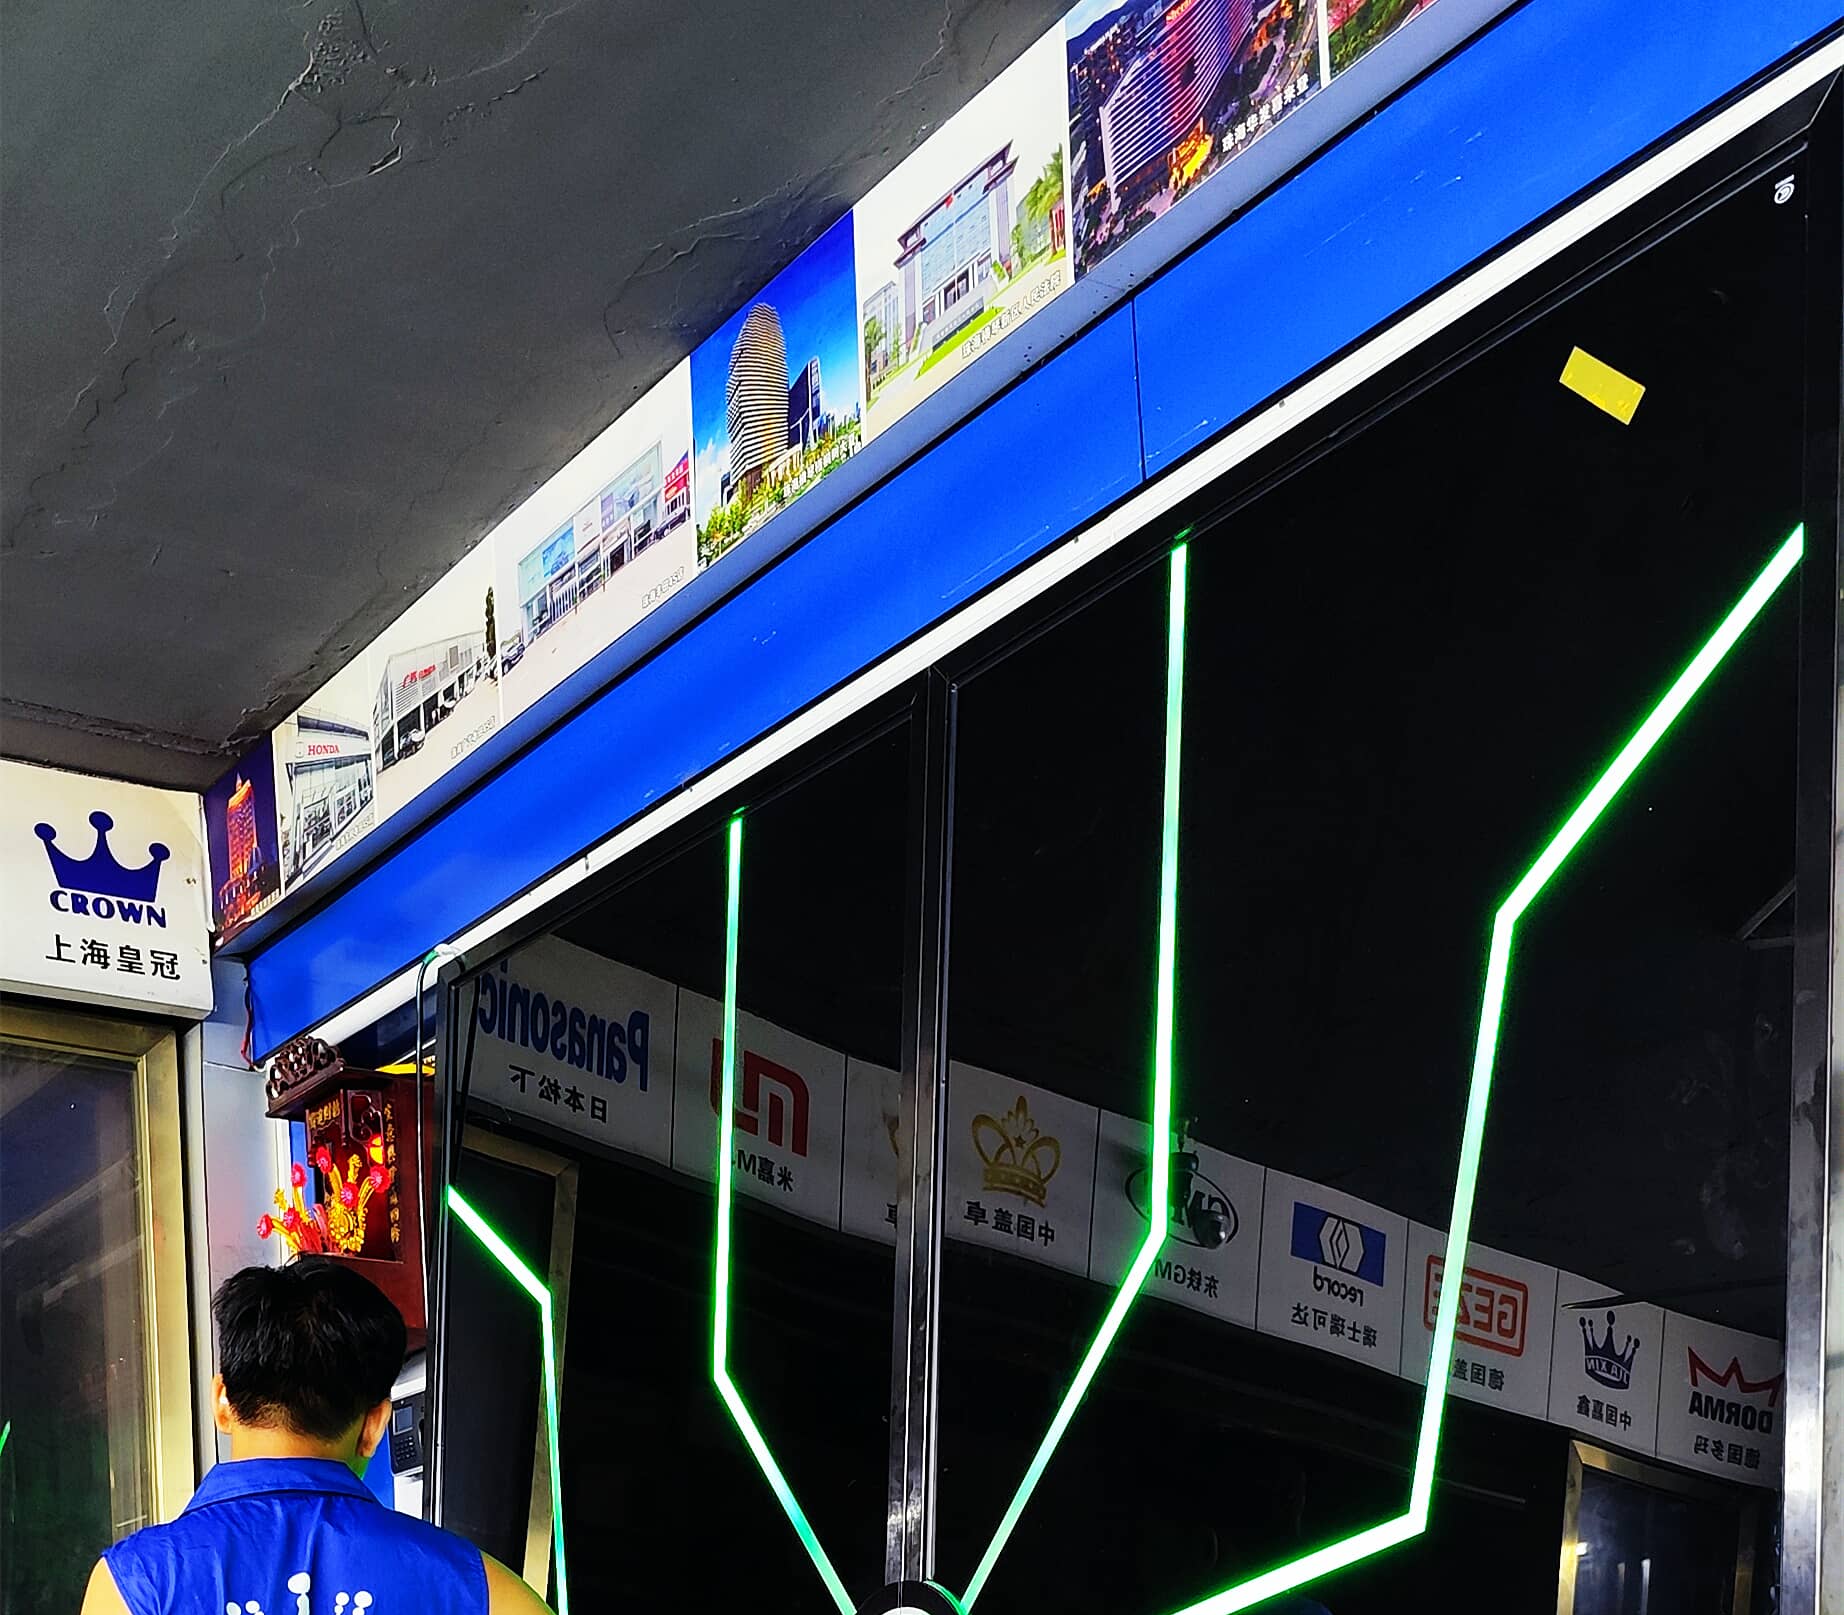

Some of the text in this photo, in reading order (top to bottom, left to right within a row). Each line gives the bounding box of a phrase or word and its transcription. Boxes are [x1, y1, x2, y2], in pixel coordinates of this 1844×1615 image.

[307, 744, 340, 756] HONDA
[49, 889, 167, 929] CROWN
[45, 933, 182, 981] 上海皇冠
